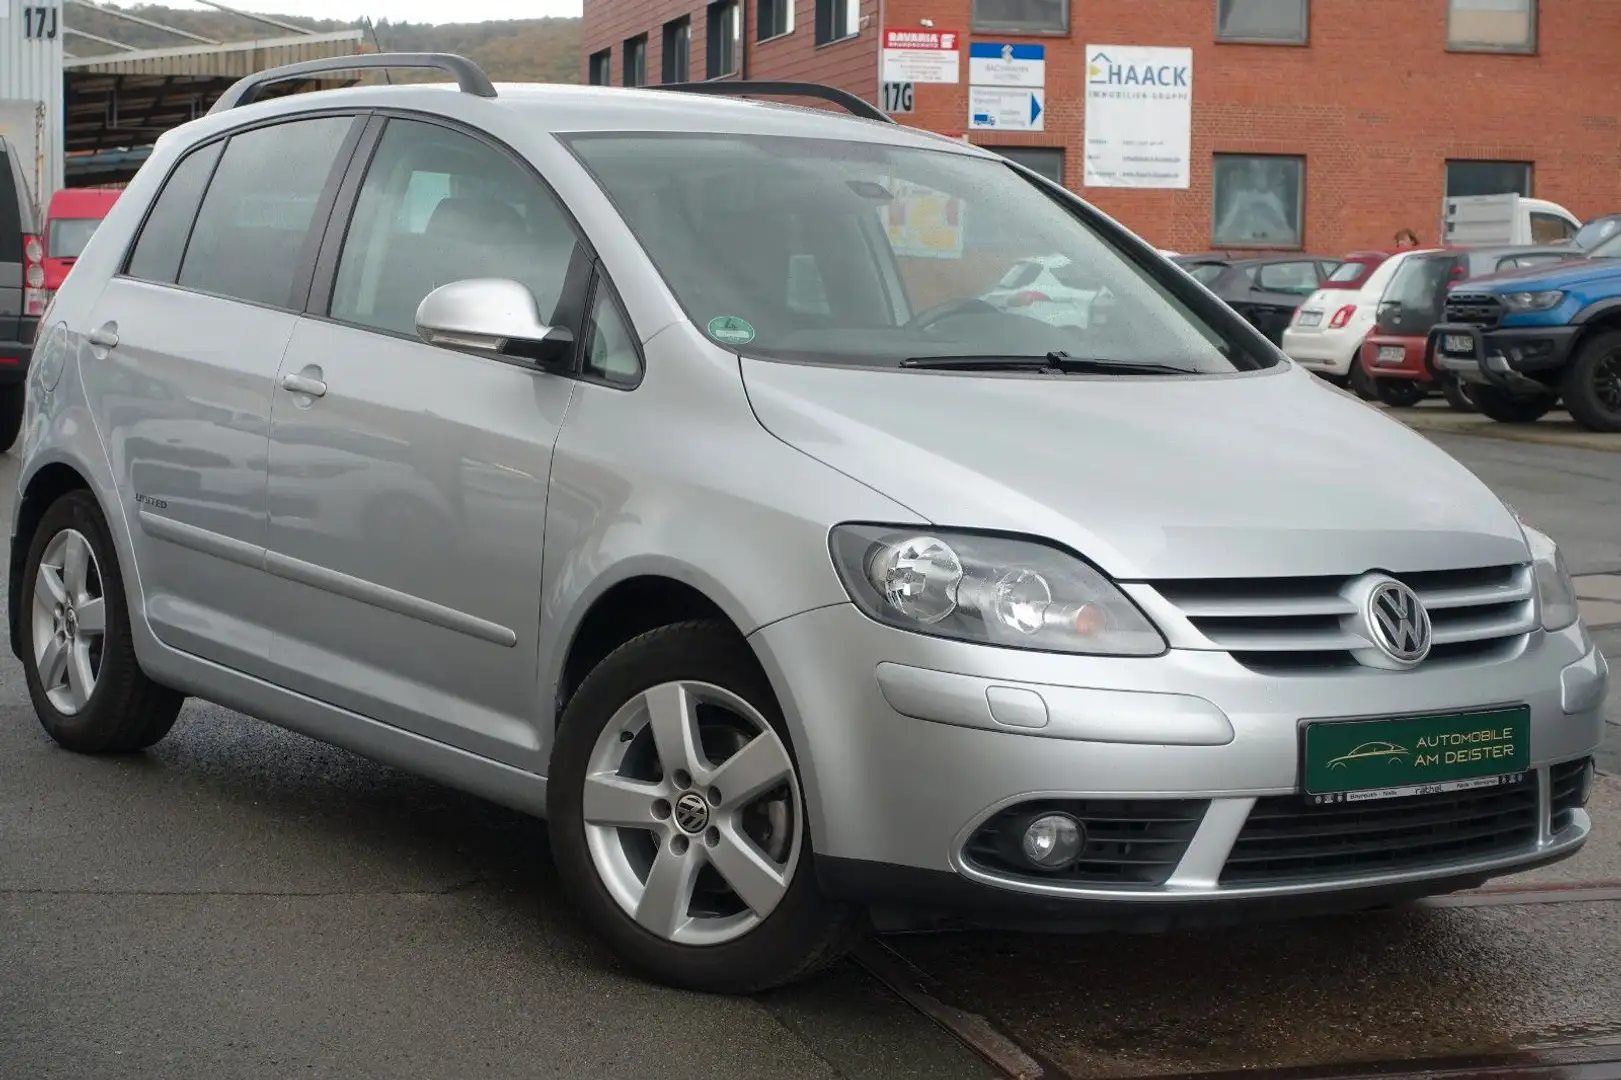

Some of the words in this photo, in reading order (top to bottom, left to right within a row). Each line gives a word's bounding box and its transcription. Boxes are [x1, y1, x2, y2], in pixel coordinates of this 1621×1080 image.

[24, 7, 57, 38] 17J
[887, 31, 939, 43] BAVARIA
[1108, 63, 1188, 87] HAACK
[884, 82, 913, 112] 17G
[1416, 727, 1514, 749] AUTOMOBILE
[1414, 754, 1440, 768] AM
[1445, 744, 1515, 765] DEISTER
